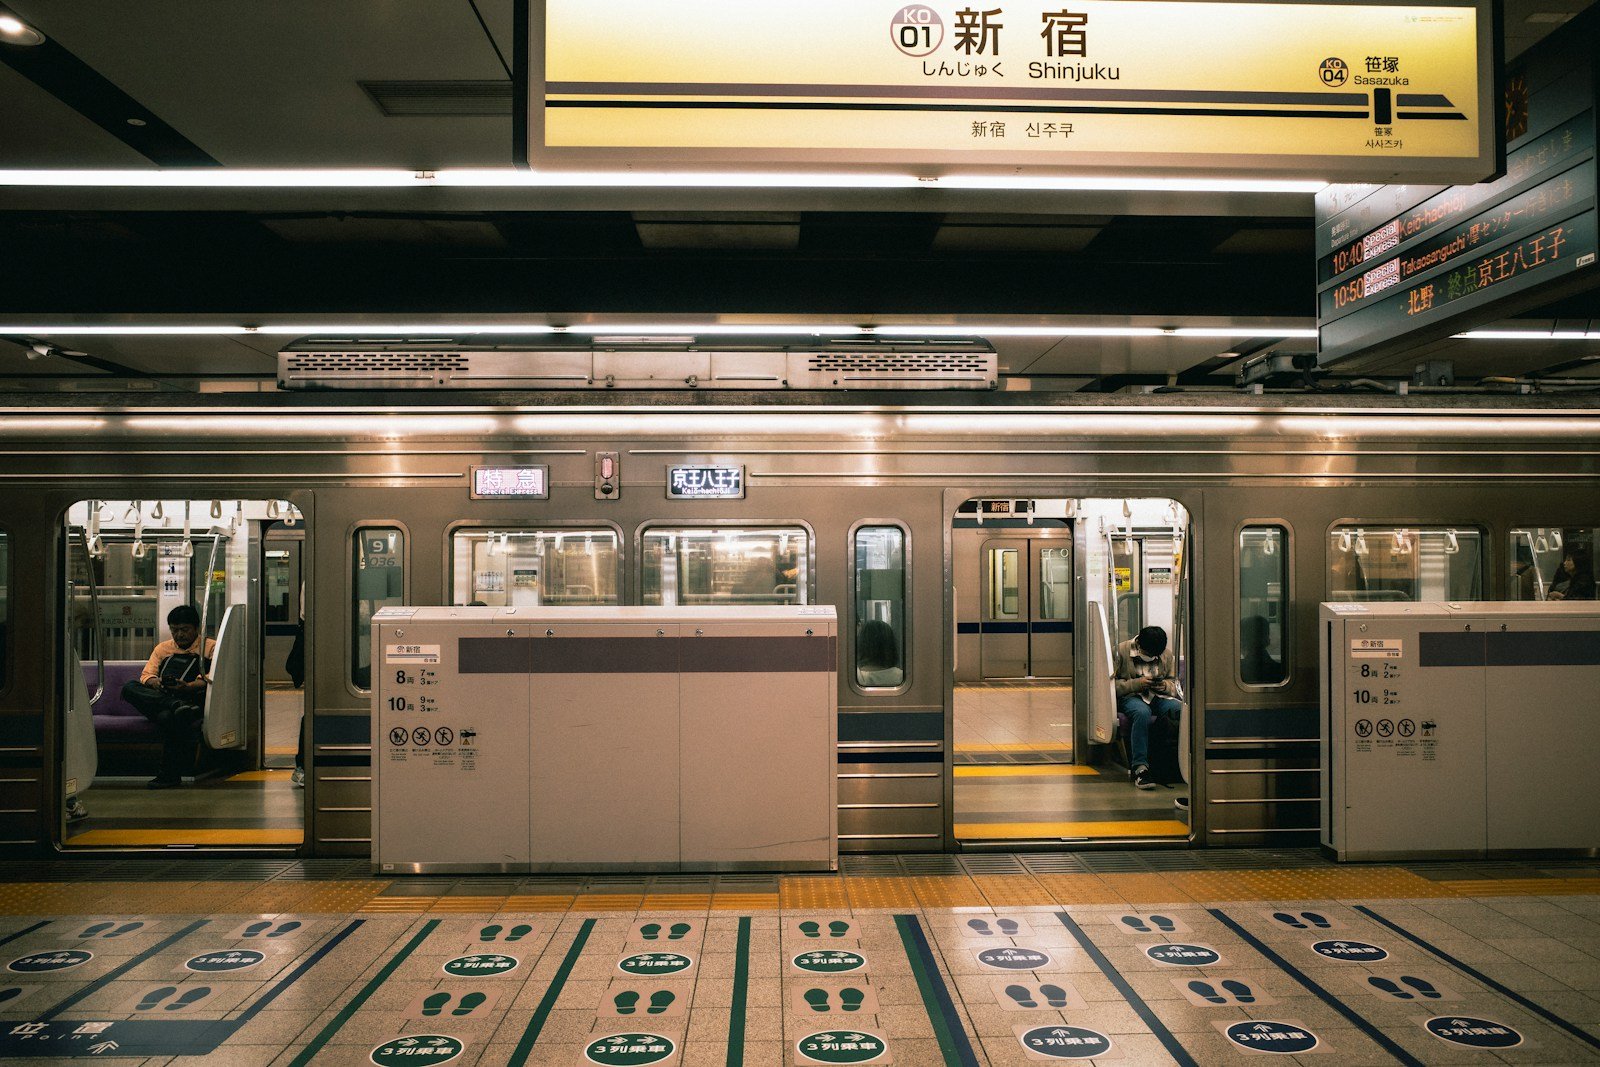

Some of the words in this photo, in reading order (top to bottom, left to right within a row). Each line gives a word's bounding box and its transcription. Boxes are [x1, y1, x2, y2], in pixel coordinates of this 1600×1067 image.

[903, 8, 931, 23] KO
[900, 26, 931, 48] 01
[953, 7, 1088, 58] 新宿
[922, 61, 1005, 77] しんじゅく
[1028, 62, 1120, 81] Shinjuku
[1325, 59, 1342, 69] KO
[1365, 56, 1399, 73] 笹塚
[1323, 69, 1345, 82] 04
[1354, 75, 1409, 86] Sasazuka
[971, 120, 1006, 138] 新宿
[1025, 121, 1075, 138] 신주쿠
[1364, 223, 1397, 247] Special
[1364, 236, 1399, 261] Express
[1400, 234, 1467, 277] Takaosanguchi
[1333, 244, 1364, 275] 10:40
[1365, 261, 1397, 284] Special
[1333, 278, 1364, 309] 10:50
[1364, 274, 1399, 298] Express
[482, 469, 537, 488] 特急
[672, 469, 740, 488] 京王八王子
[372, 540, 384, 553] 9
[1236, 1032, 1308, 1042] 3列乗車
[1438, 1027, 1510, 1037] 3列乗車
[595, 1045, 669, 1054] 3列乗車
[807, 1042, 878, 1051] 3列乗車
[1031, 1037, 1102, 1046] 3列乗車
[380, 1046, 455, 1056] 3列乗車
